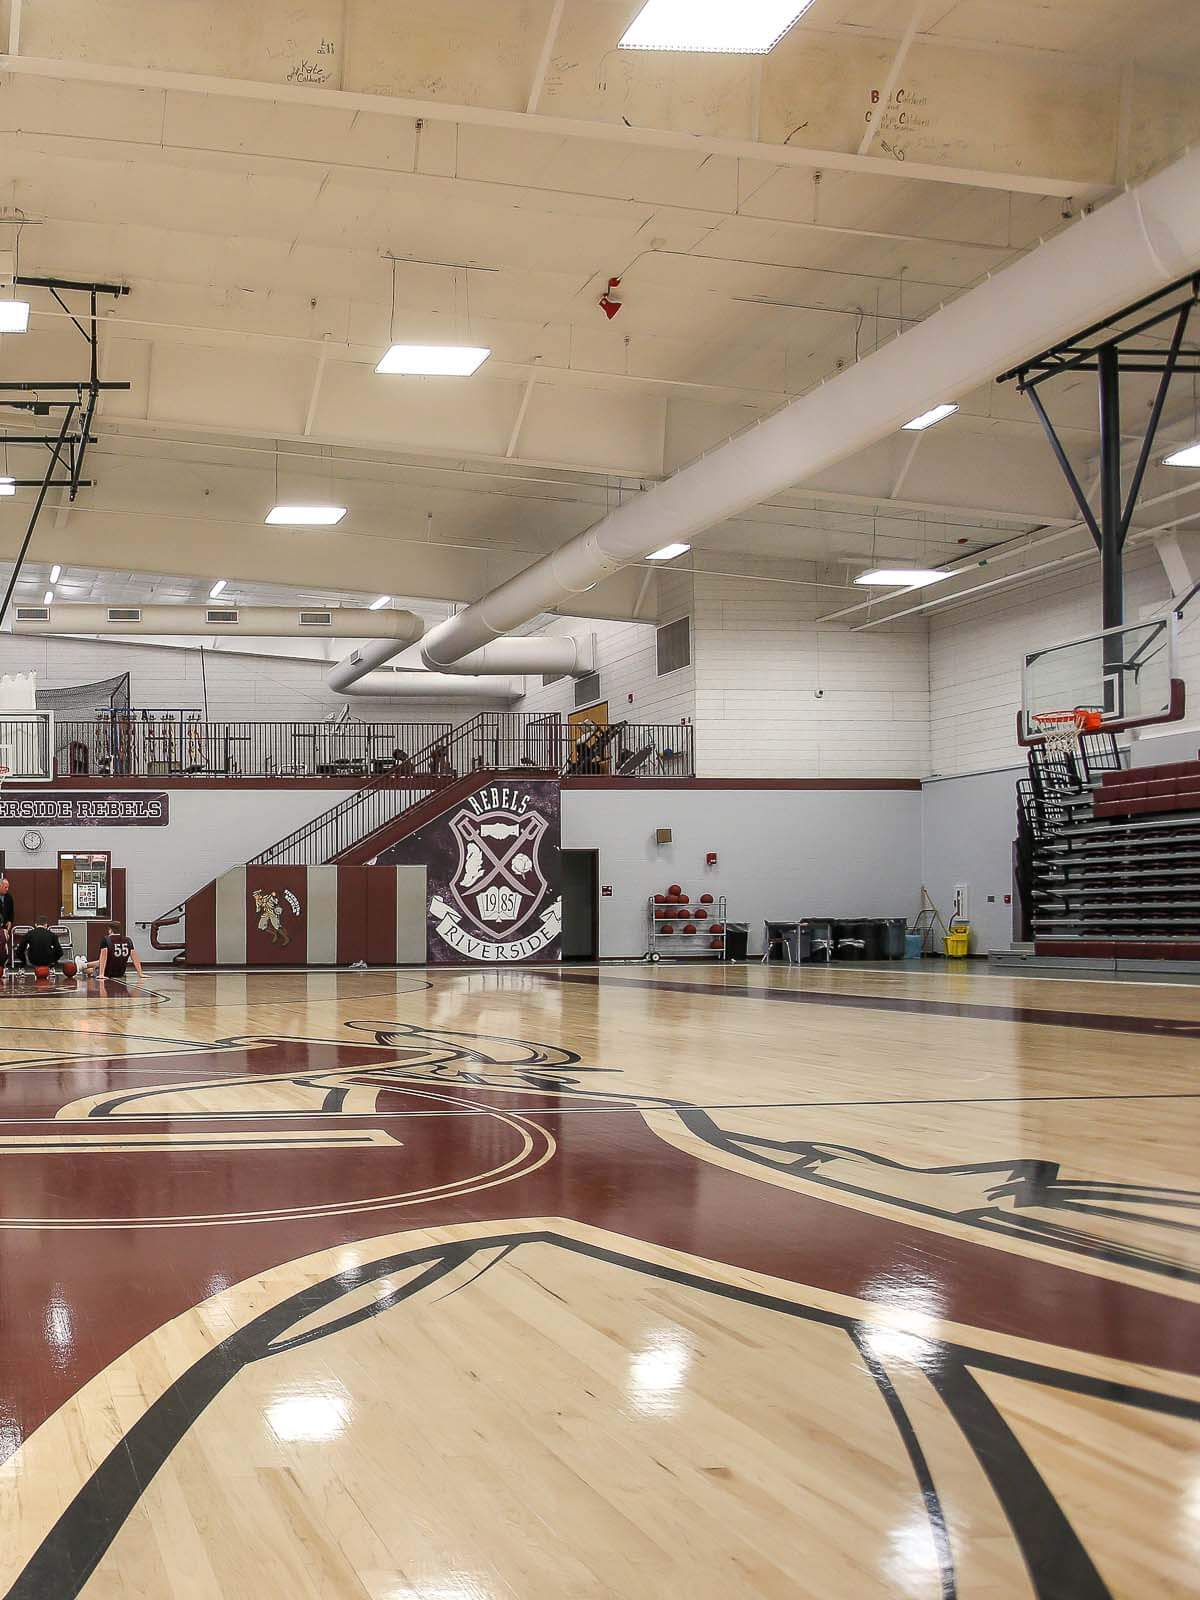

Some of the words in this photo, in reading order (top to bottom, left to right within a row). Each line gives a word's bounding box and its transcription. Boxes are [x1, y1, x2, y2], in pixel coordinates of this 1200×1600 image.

[76, 800, 162, 818] REBELS
[468, 787, 531, 815] REBELS
[113, 943, 129, 957] 55
[444, 925, 555, 959] RIVERSIDE
